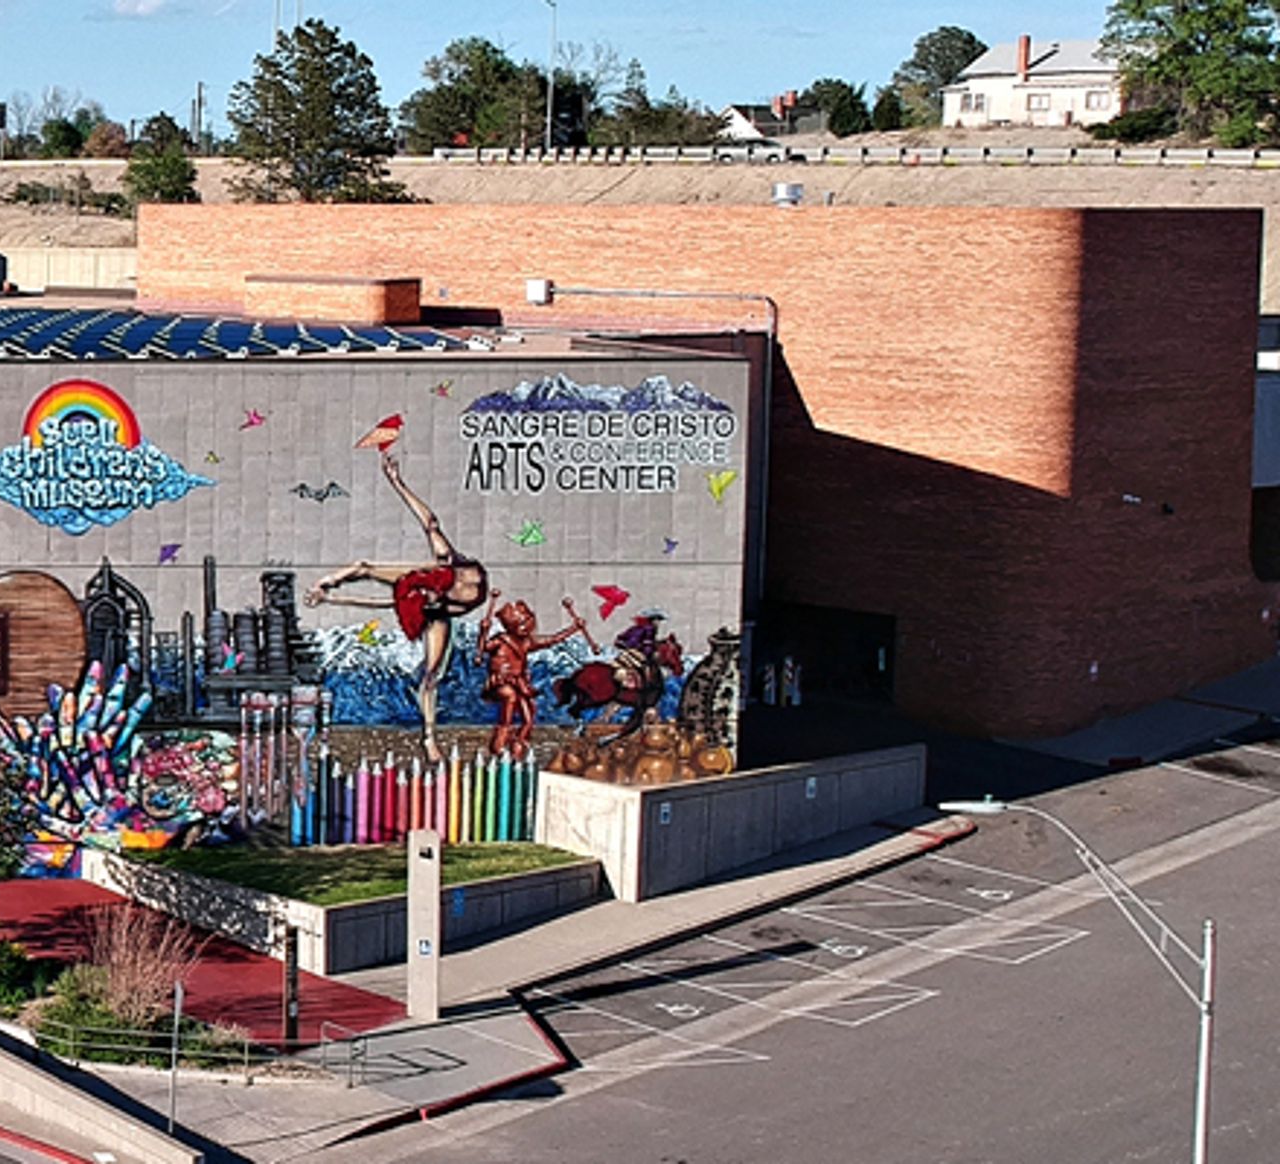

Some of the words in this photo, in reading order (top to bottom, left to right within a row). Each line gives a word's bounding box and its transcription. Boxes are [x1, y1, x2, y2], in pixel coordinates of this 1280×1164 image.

[461, 414, 579, 438] SANGRE
[587, 414, 624, 438] DE
[633, 413, 735, 438] CRISTO
[550, 443, 566, 461] &
[570, 442, 728, 463] CONFERENCE
[464, 441, 546, 492] ARTS
[556, 465, 677, 491] CENTER
